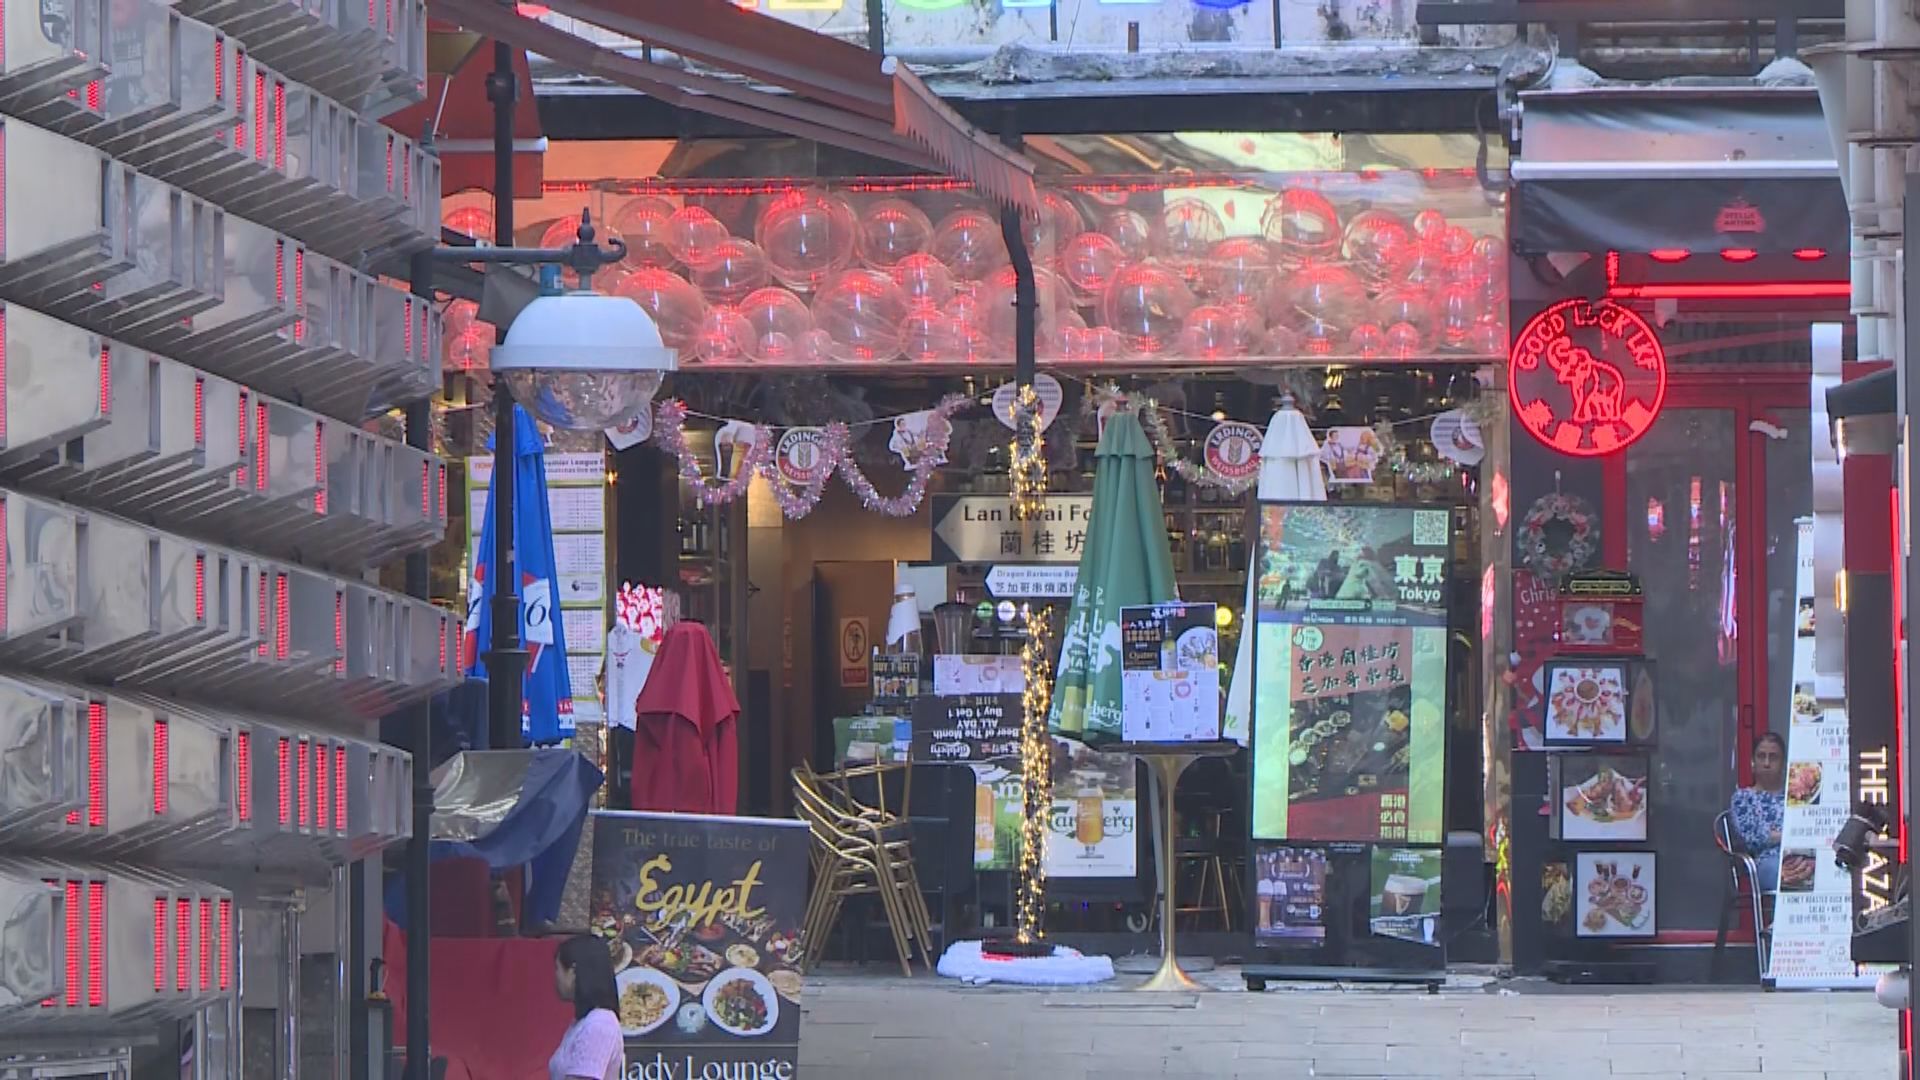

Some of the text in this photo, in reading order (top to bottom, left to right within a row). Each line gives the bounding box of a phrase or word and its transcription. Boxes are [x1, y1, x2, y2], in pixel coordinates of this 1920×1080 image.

[964, 505, 1002, 521] Lan
[1000, 530, 1087, 556] 蘭桂坊
[1393, 554, 1445, 584] 東京
[1398, 587, 1441, 604] Tokyo
[956, 708, 973, 718] Get
[984, 707, 1003, 717] Buy
[933, 728, 1019, 739] Beer of The Month
[956, 719, 998, 728] ALL DAY
[1859, 746, 1889, 805] THE
[622, 828, 778, 851] The true taste of
[635, 853, 767, 932] Egypt
[686, 1055, 793, 1080] Lounge
